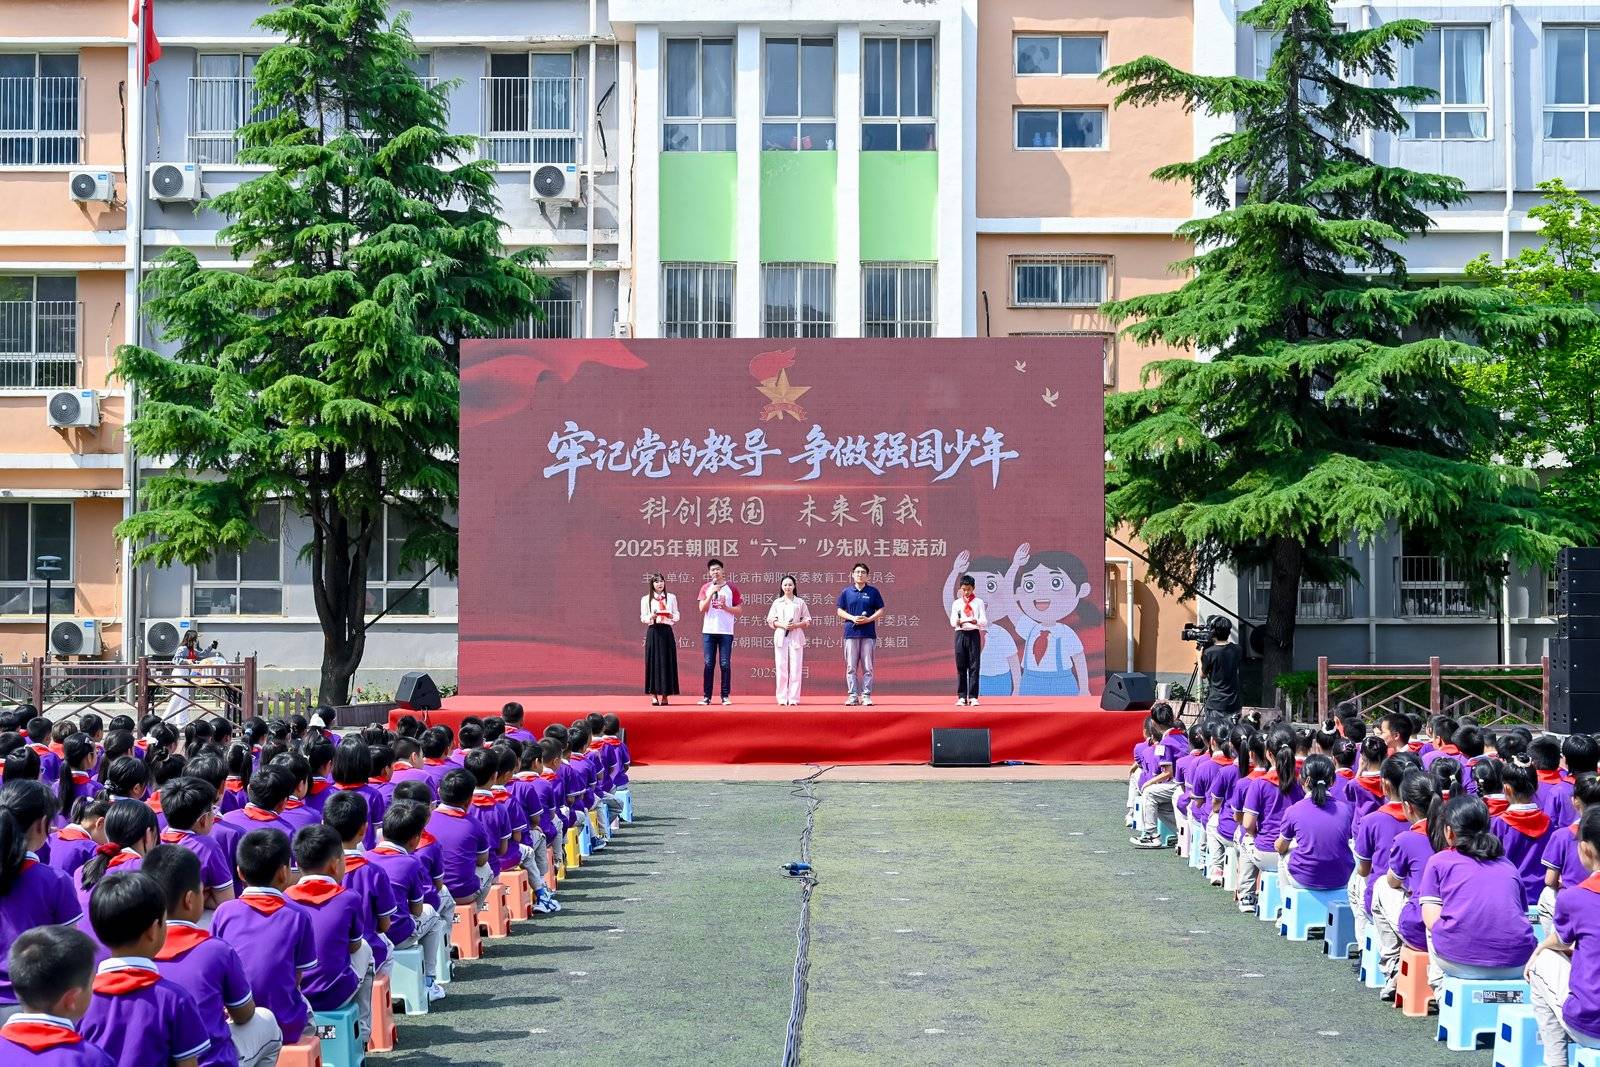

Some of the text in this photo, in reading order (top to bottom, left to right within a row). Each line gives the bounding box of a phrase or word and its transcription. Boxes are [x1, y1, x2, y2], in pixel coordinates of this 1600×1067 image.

[543, 420, 1020, 504] 牢记党的教导 争做强国少年
[638, 494, 923, 529] 科创强国 未来有我
[614, 537, 948, 558] 2025年朝阳区“六一”少先队主题活动
